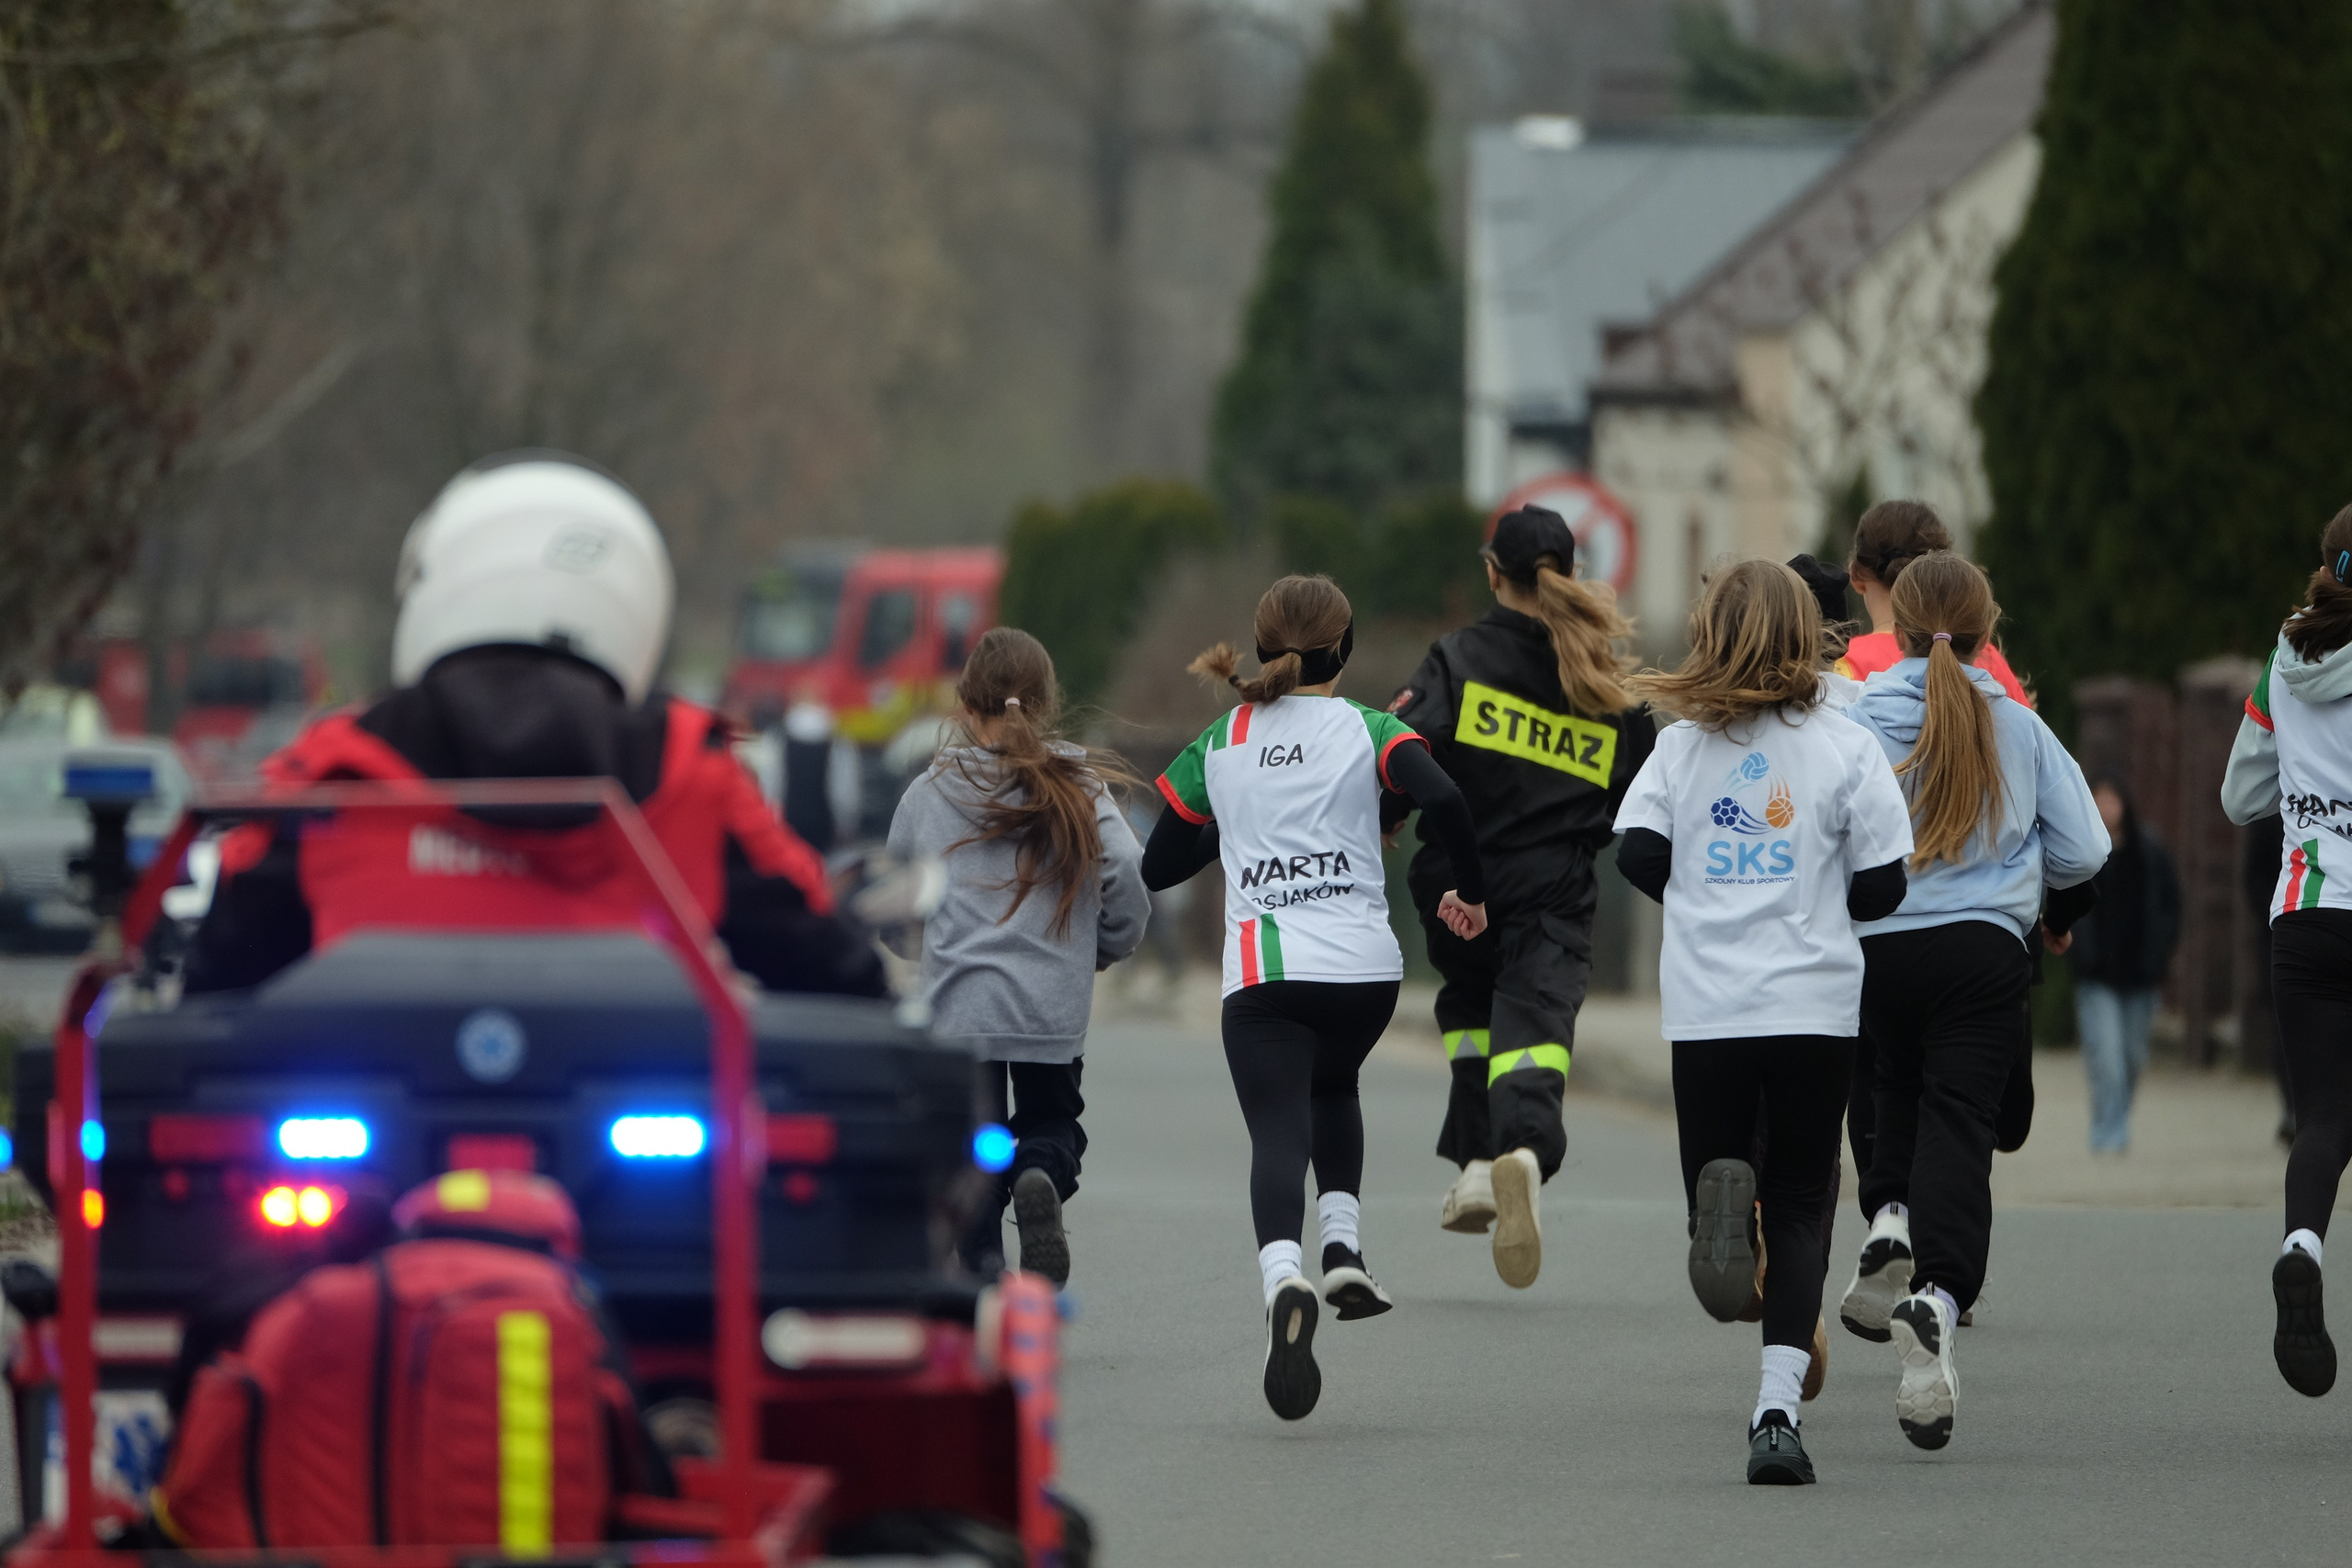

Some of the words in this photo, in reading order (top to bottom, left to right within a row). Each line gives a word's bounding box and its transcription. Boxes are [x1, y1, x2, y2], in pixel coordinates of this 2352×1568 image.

[1260, 743, 1304, 767] IGA
[1706, 840, 1794, 875] SKS
[1757, 876, 1795, 885] SPORTOWY
